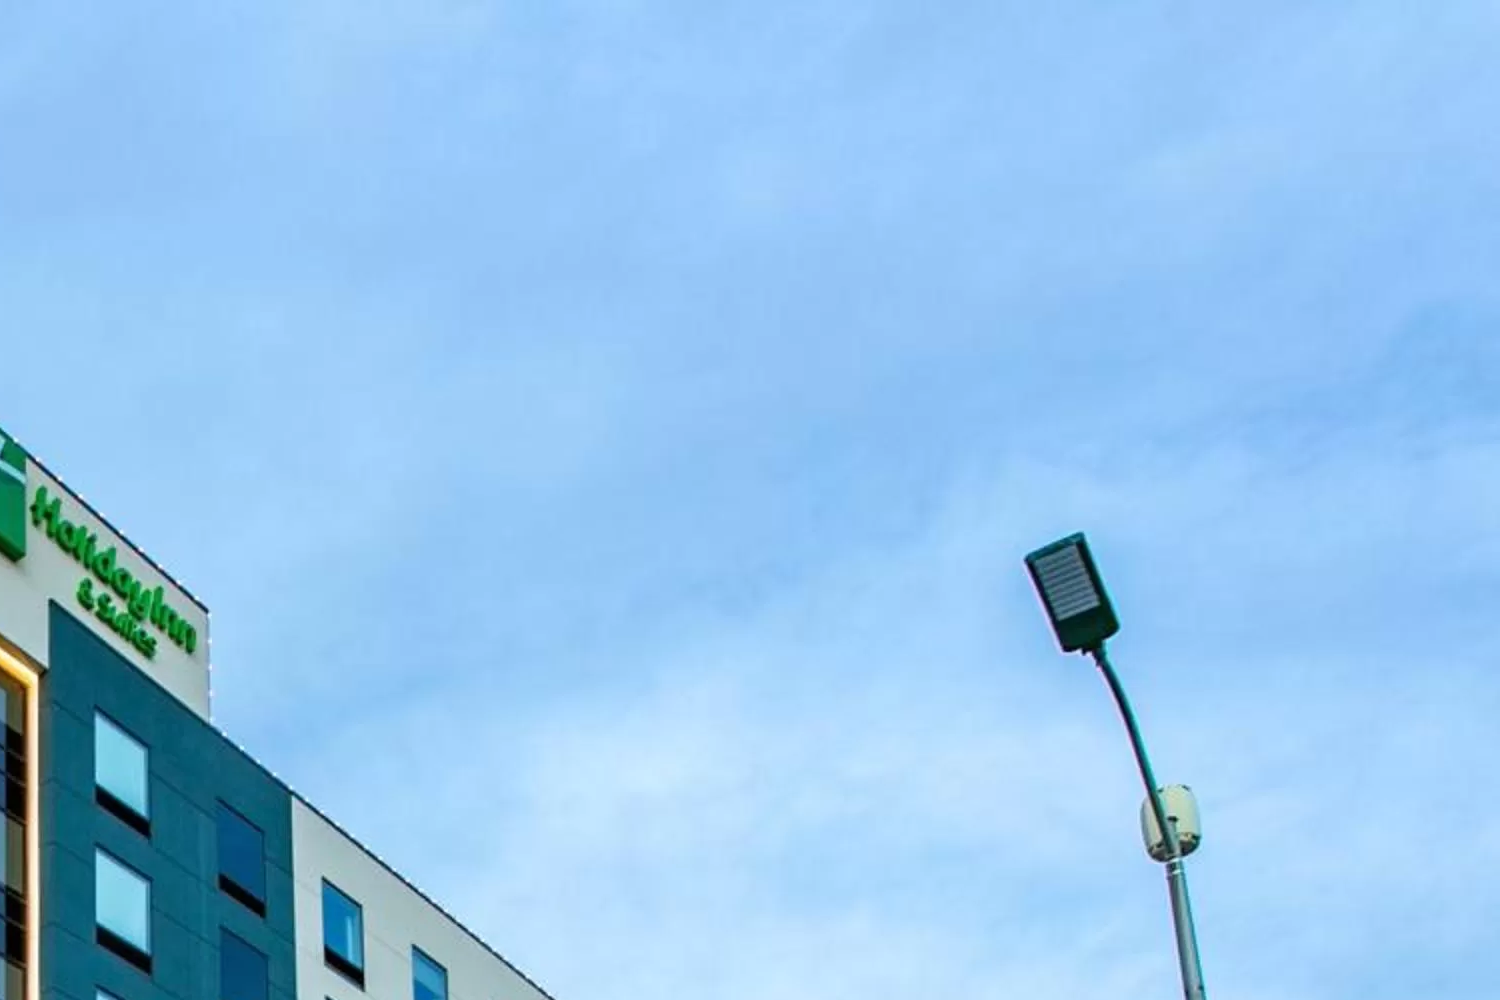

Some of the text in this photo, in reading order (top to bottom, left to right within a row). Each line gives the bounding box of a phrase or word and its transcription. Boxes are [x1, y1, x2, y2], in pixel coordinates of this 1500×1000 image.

[30, 485, 197, 655] Holiday Inn
[76, 577, 158, 661] & Suites
